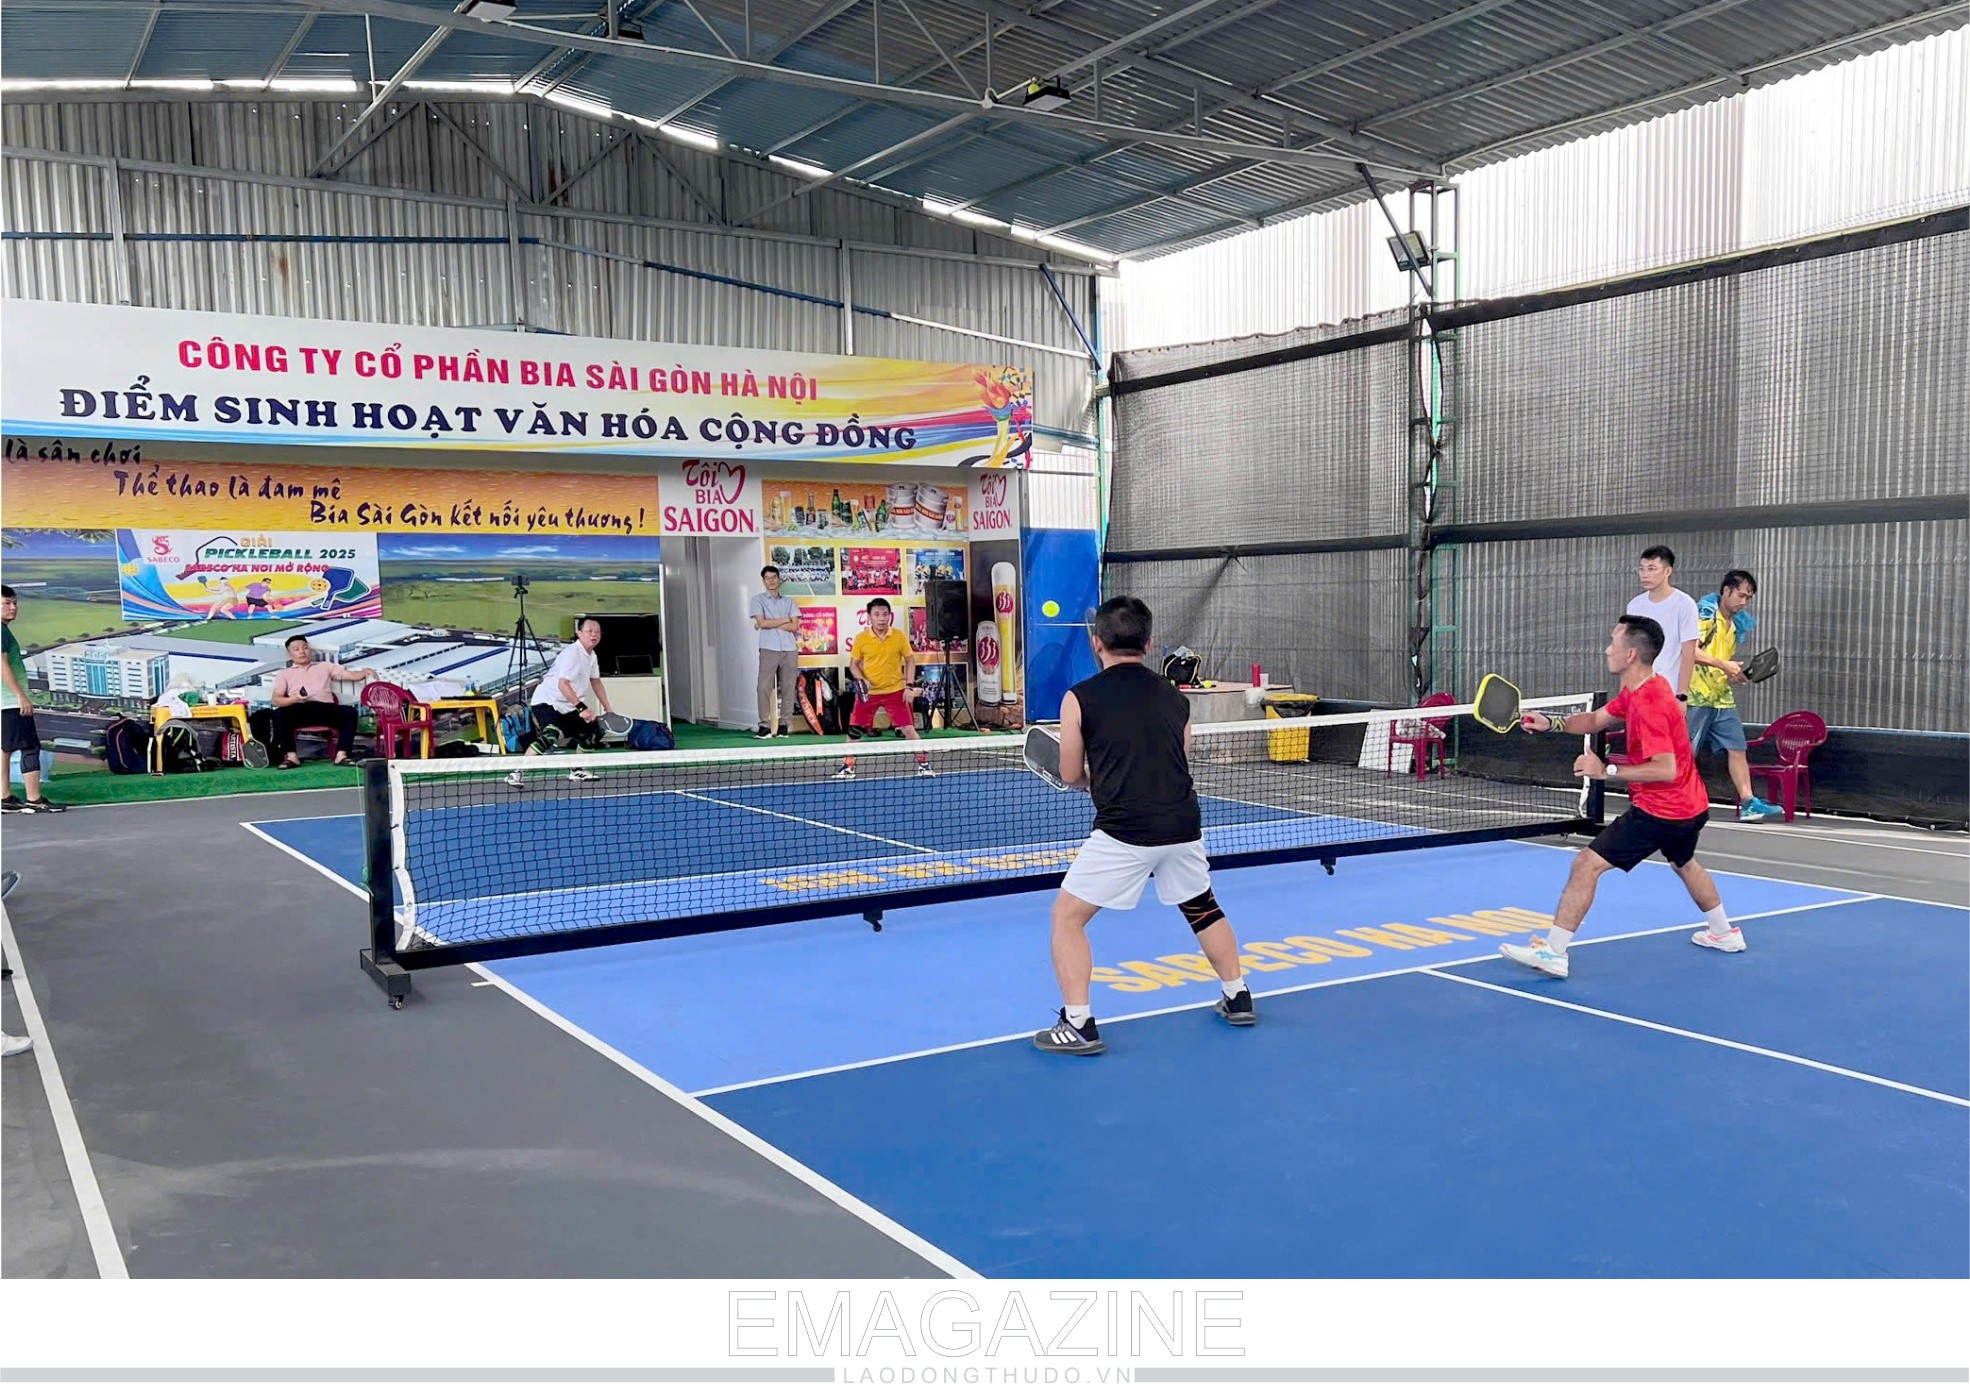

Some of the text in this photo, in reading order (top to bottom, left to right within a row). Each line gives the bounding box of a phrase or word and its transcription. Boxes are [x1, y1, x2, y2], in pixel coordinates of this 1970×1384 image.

[178, 336, 818, 404] CÔNG TY CỔ PHẦN BIA SÀI GÒN HÀ NỘI
[60, 374, 917, 451] ĐIỂM SINH HOẠT VĂN HÓA CỘNG ĐỒNG
[5, 438, 141, 465] là sân chơi
[114, 465, 341, 500] Thể thao là đam mê
[695, 489, 724, 505] BIA
[985, 496, 997, 508] BIA
[310, 500, 349, 525] Bia
[357, 502, 392, 526] Sài
[400, 504, 442, 527] Gòn
[489, 500, 519, 527] nối
[527, 507, 559, 531] yêu
[664, 506, 754, 533] SAIGON
[973, 510, 1011, 530] SAIGON
[204, 548, 356, 559] PICKLEBALL 2025
[1334, 923, 1477, 950] HA
